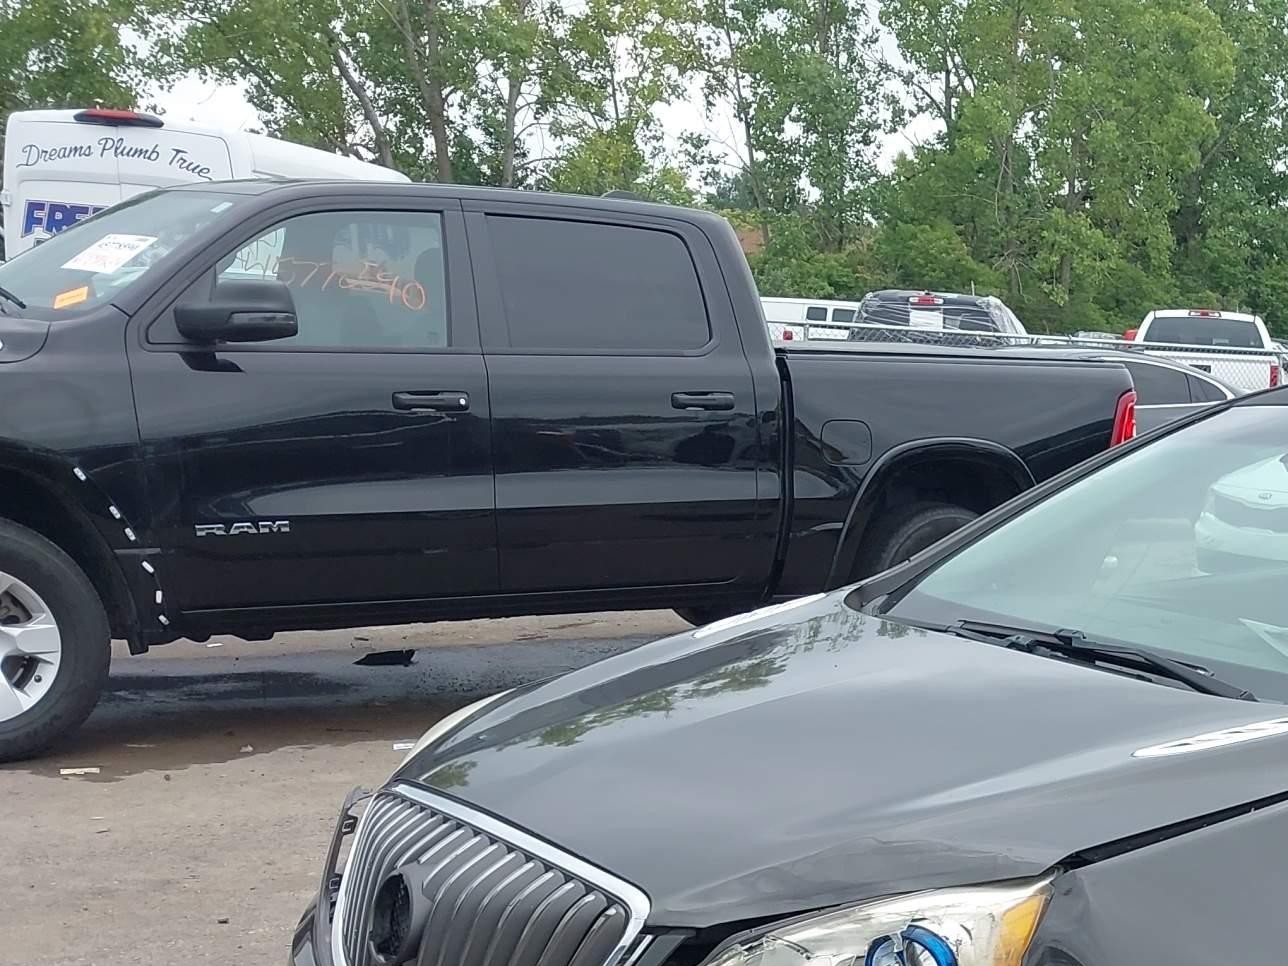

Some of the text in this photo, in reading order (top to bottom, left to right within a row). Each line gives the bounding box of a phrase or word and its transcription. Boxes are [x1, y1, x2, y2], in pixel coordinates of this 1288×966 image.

[16, 137, 213, 181] Dreams Plumb True
[195, 520, 290, 537] RAM
